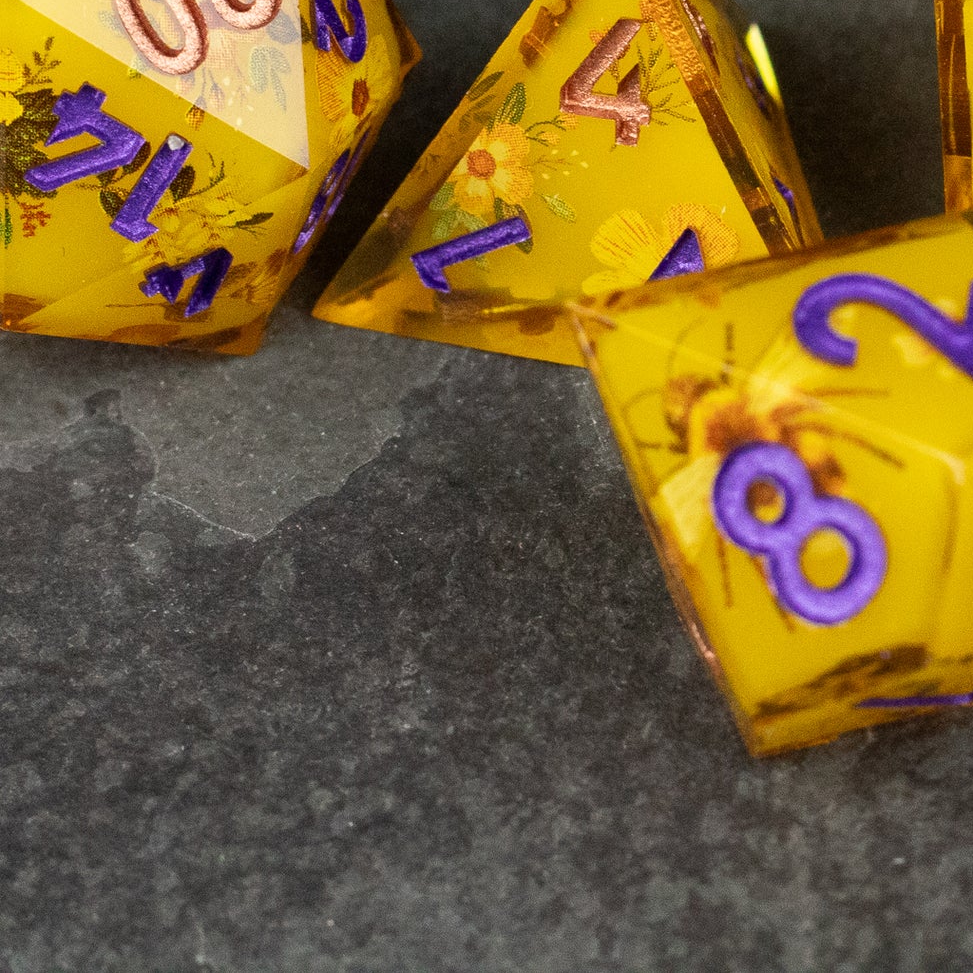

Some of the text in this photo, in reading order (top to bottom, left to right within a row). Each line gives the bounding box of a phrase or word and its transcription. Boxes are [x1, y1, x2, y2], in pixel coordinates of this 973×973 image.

[559, 17, 653, 148] 4
[24, 82, 193, 243] 14
[138, 246, 234, 318] 4
[410, 217, 533, 293] 1
[713, 442, 887, 627] 8
